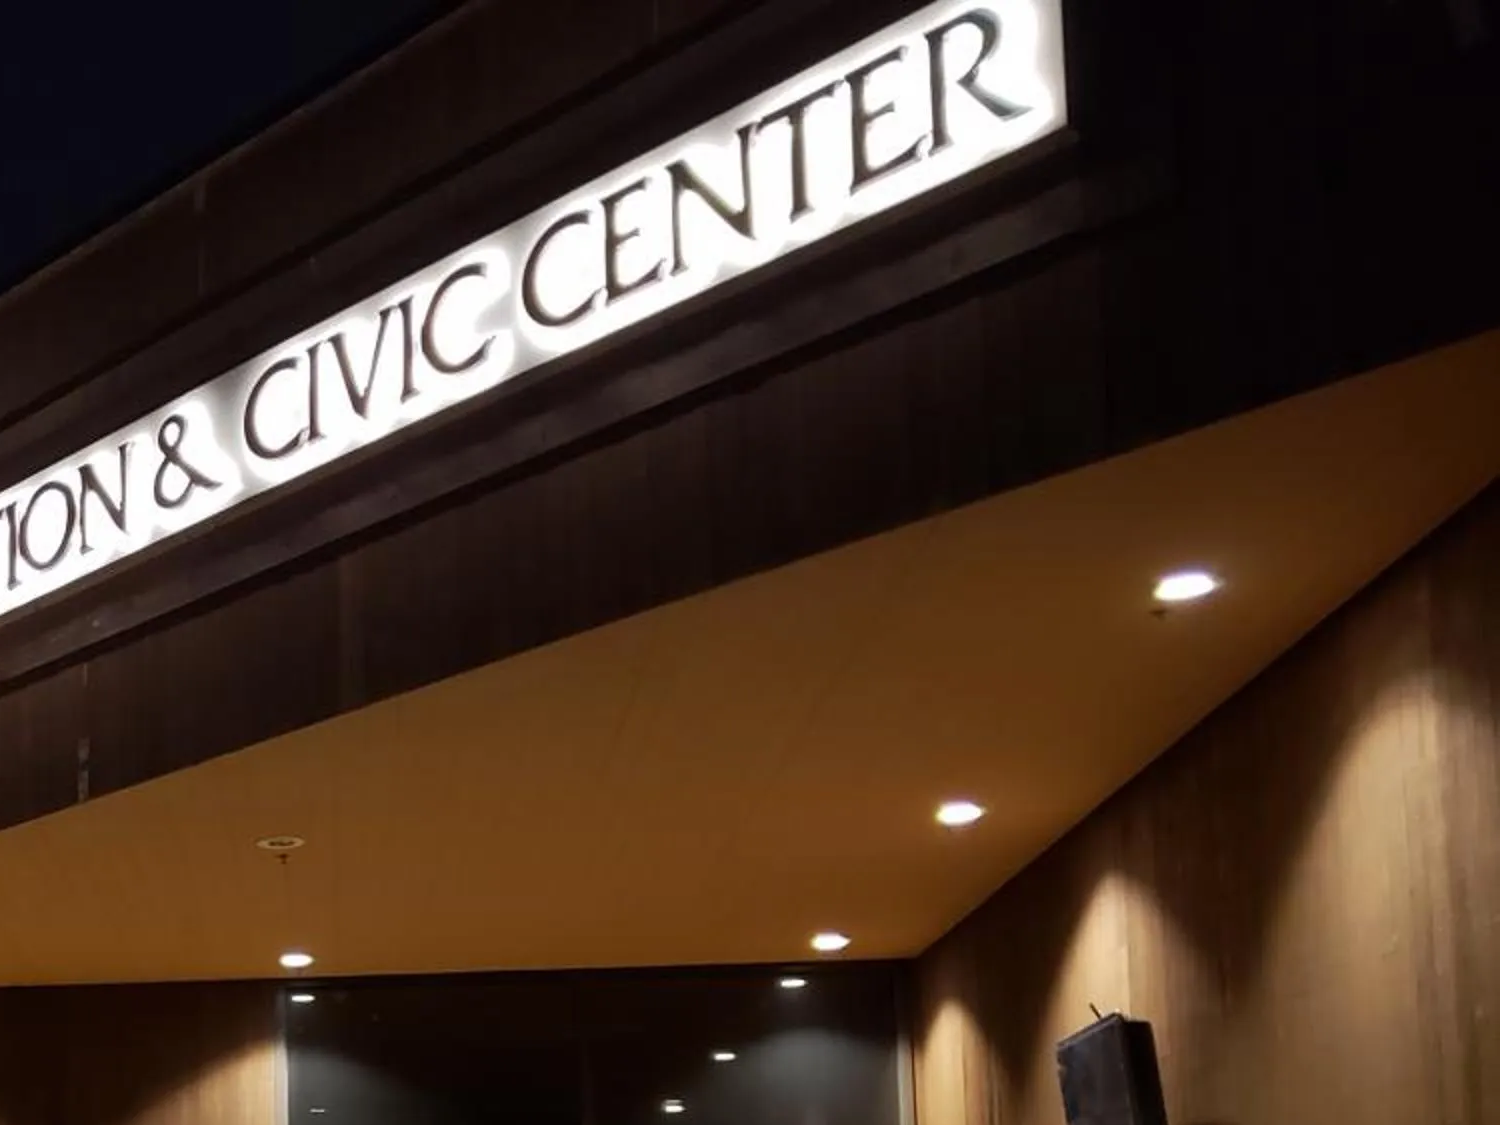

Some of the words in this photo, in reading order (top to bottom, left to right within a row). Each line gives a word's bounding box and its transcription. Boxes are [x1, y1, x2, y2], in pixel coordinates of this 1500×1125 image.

[154, 415, 222, 509] &
[244, 263, 496, 459] CIVIC
[522, 8, 1032, 328] CENTER
